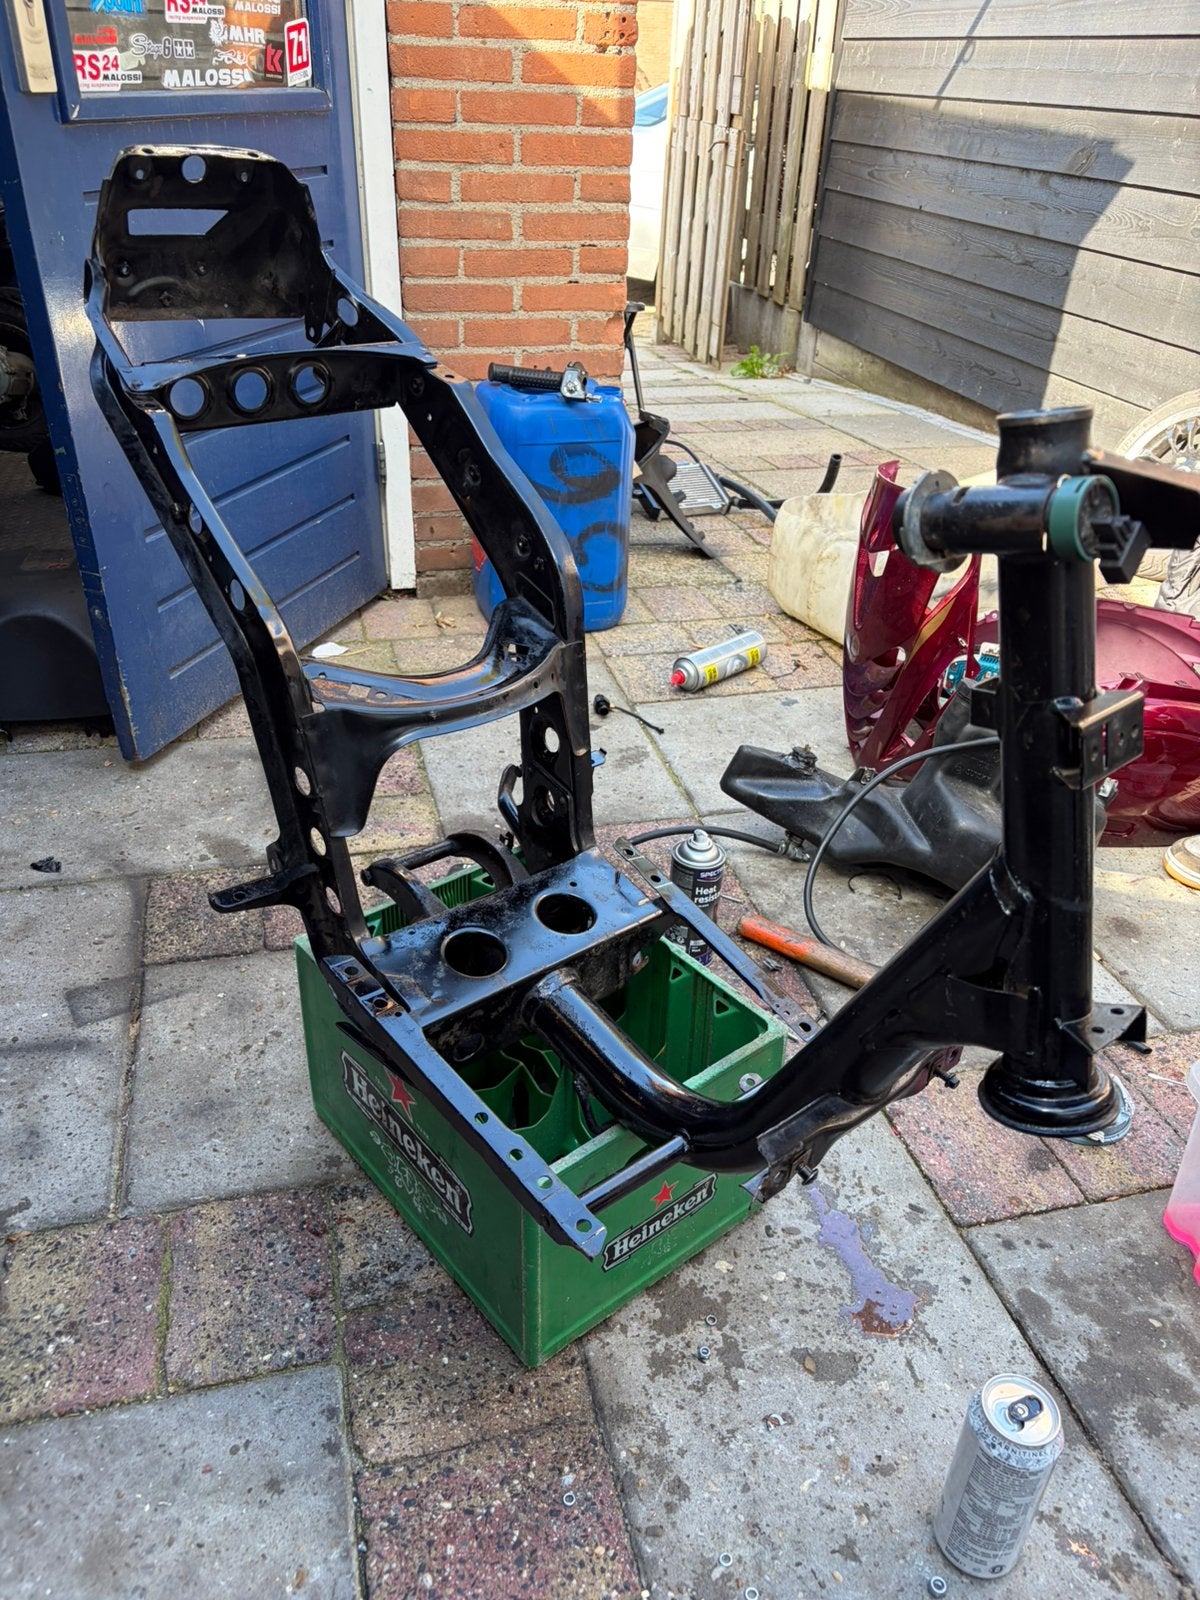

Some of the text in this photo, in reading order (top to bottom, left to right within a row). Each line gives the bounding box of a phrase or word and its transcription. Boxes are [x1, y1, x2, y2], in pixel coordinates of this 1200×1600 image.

[191, 7, 225, 15] MALOSSI
[234, 0, 281, 15] MALOSSI
[229, 25, 266, 44] MHR
[289, 28, 308, 66] 7.1
[102, 73, 141, 81] MALOSSI
[164, 68, 251, 88] MALOSSI
[695, 885, 717, 896] Heat
[351, 1066, 462, 1214] Heineken
[613, 1187, 709, 1261] Heineken
